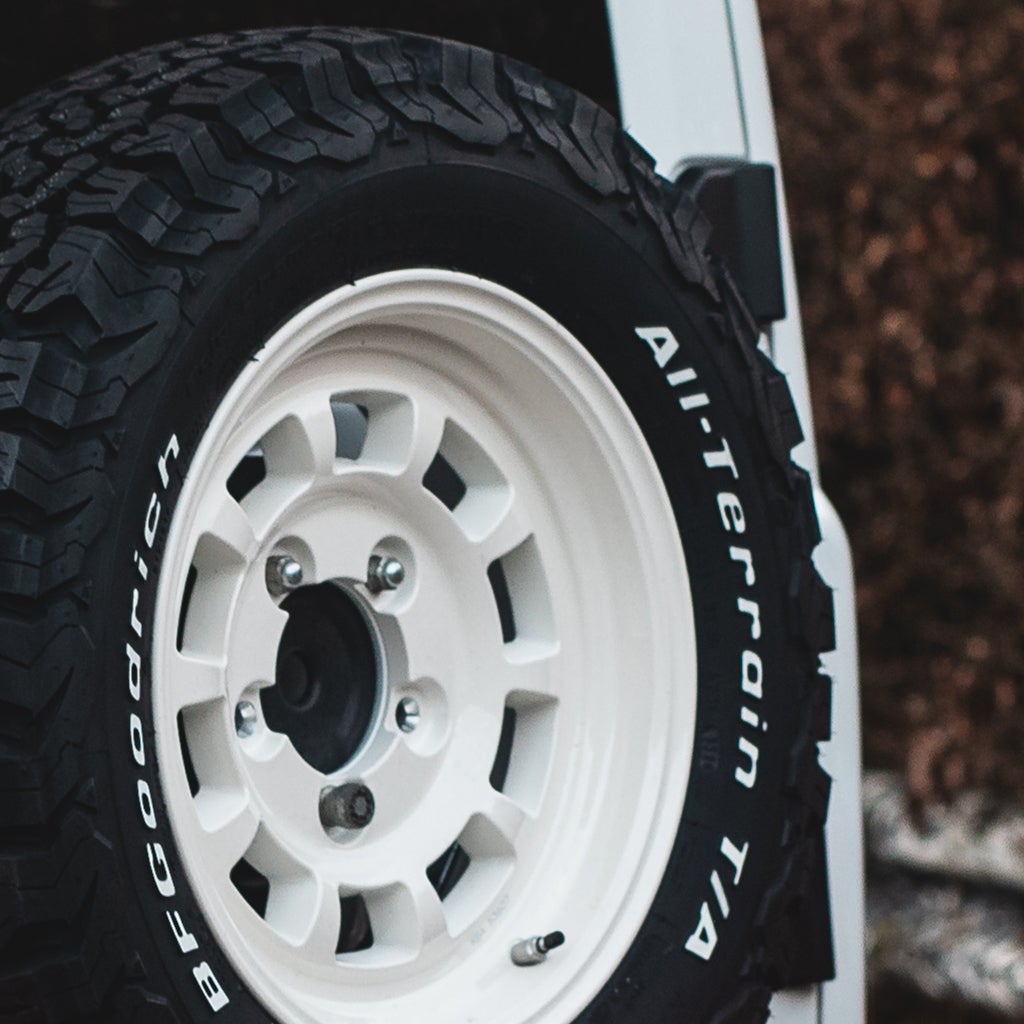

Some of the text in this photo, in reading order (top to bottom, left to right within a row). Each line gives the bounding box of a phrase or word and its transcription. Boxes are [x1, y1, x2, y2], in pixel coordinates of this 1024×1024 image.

[125, 432, 231, 1013] BFGoodrich
[634, 326, 769, 962] All-Terrain T/A
